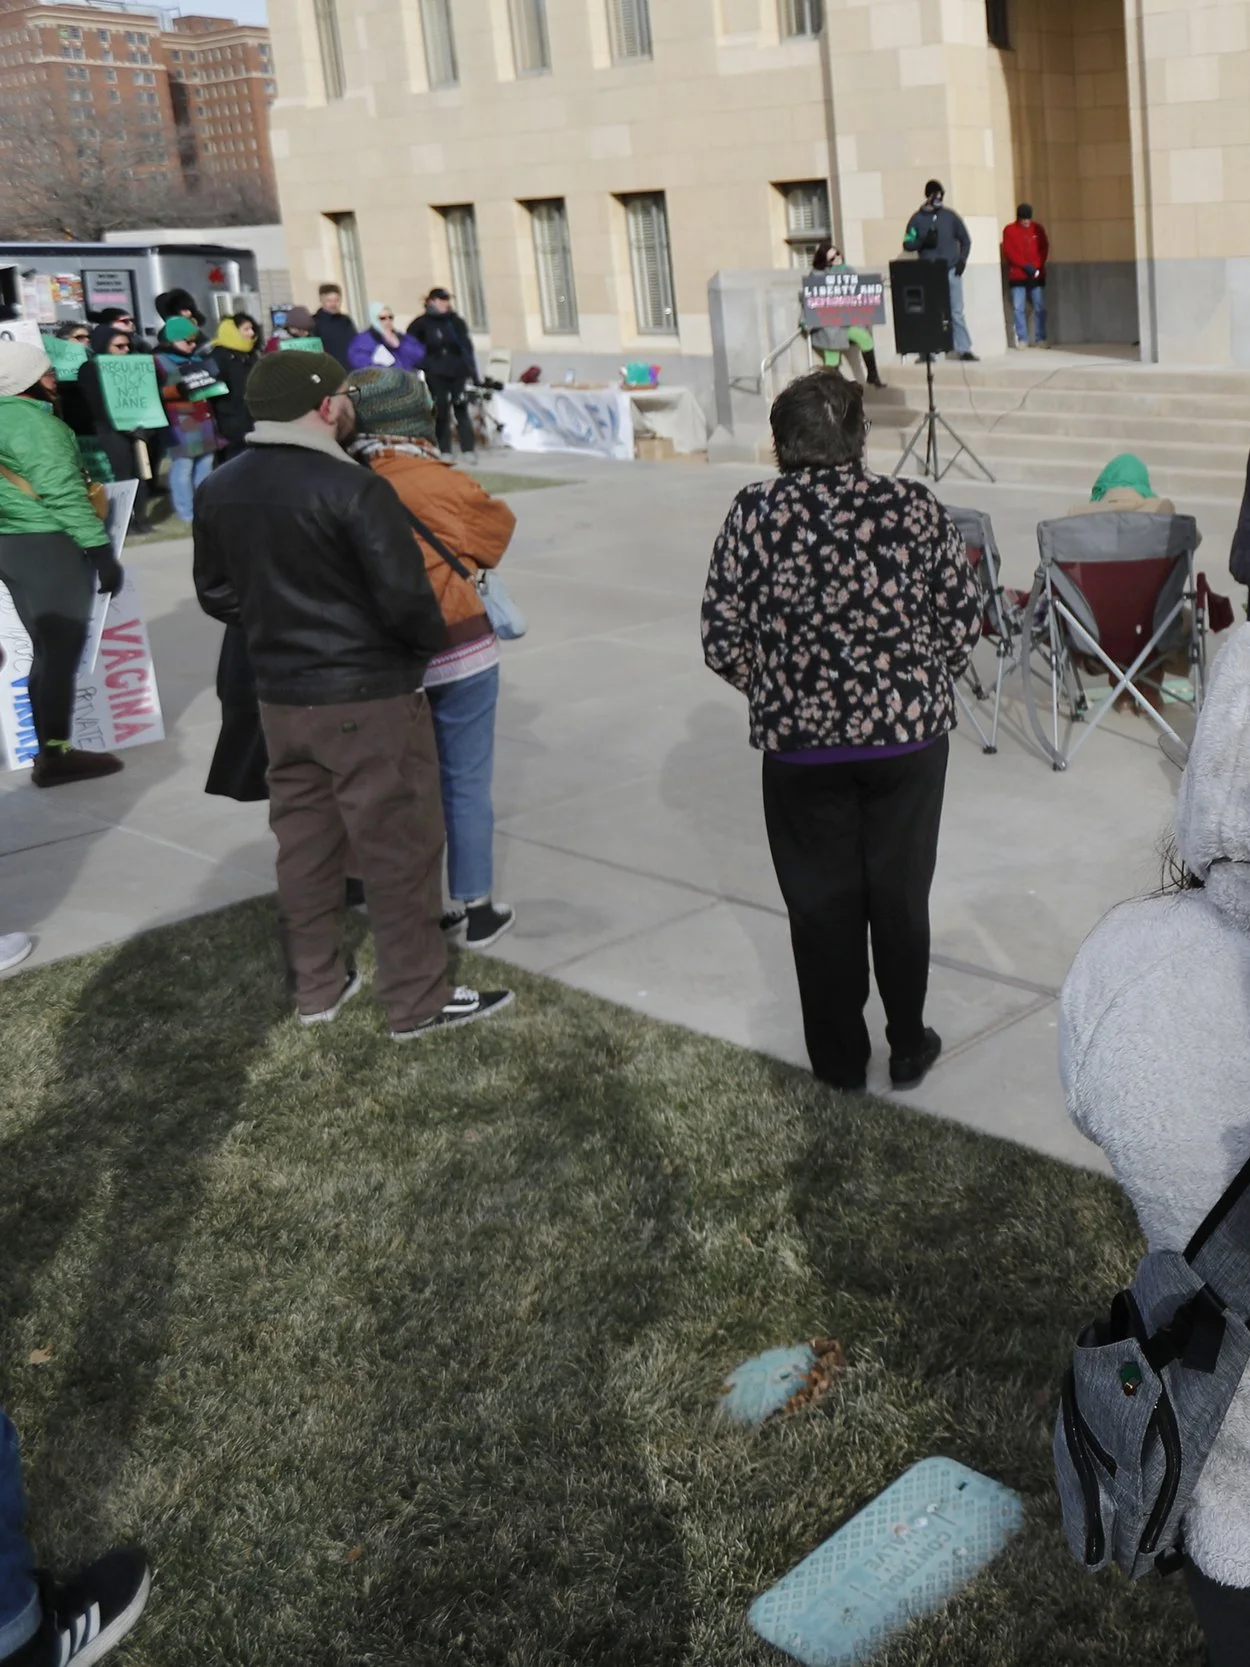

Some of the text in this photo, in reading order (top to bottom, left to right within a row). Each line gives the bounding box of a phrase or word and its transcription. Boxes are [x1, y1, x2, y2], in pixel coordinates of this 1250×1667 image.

[825, 274, 858, 285] WITH
[804, 283, 883, 297] LIBERTY AND
[112, 372, 147, 386] DICK
[117, 387, 140, 397] NOT
[114, 397, 148, 408] JANE
[101, 618, 156, 743] VAGINA
[879, 1531, 953, 1593] CONTROL
